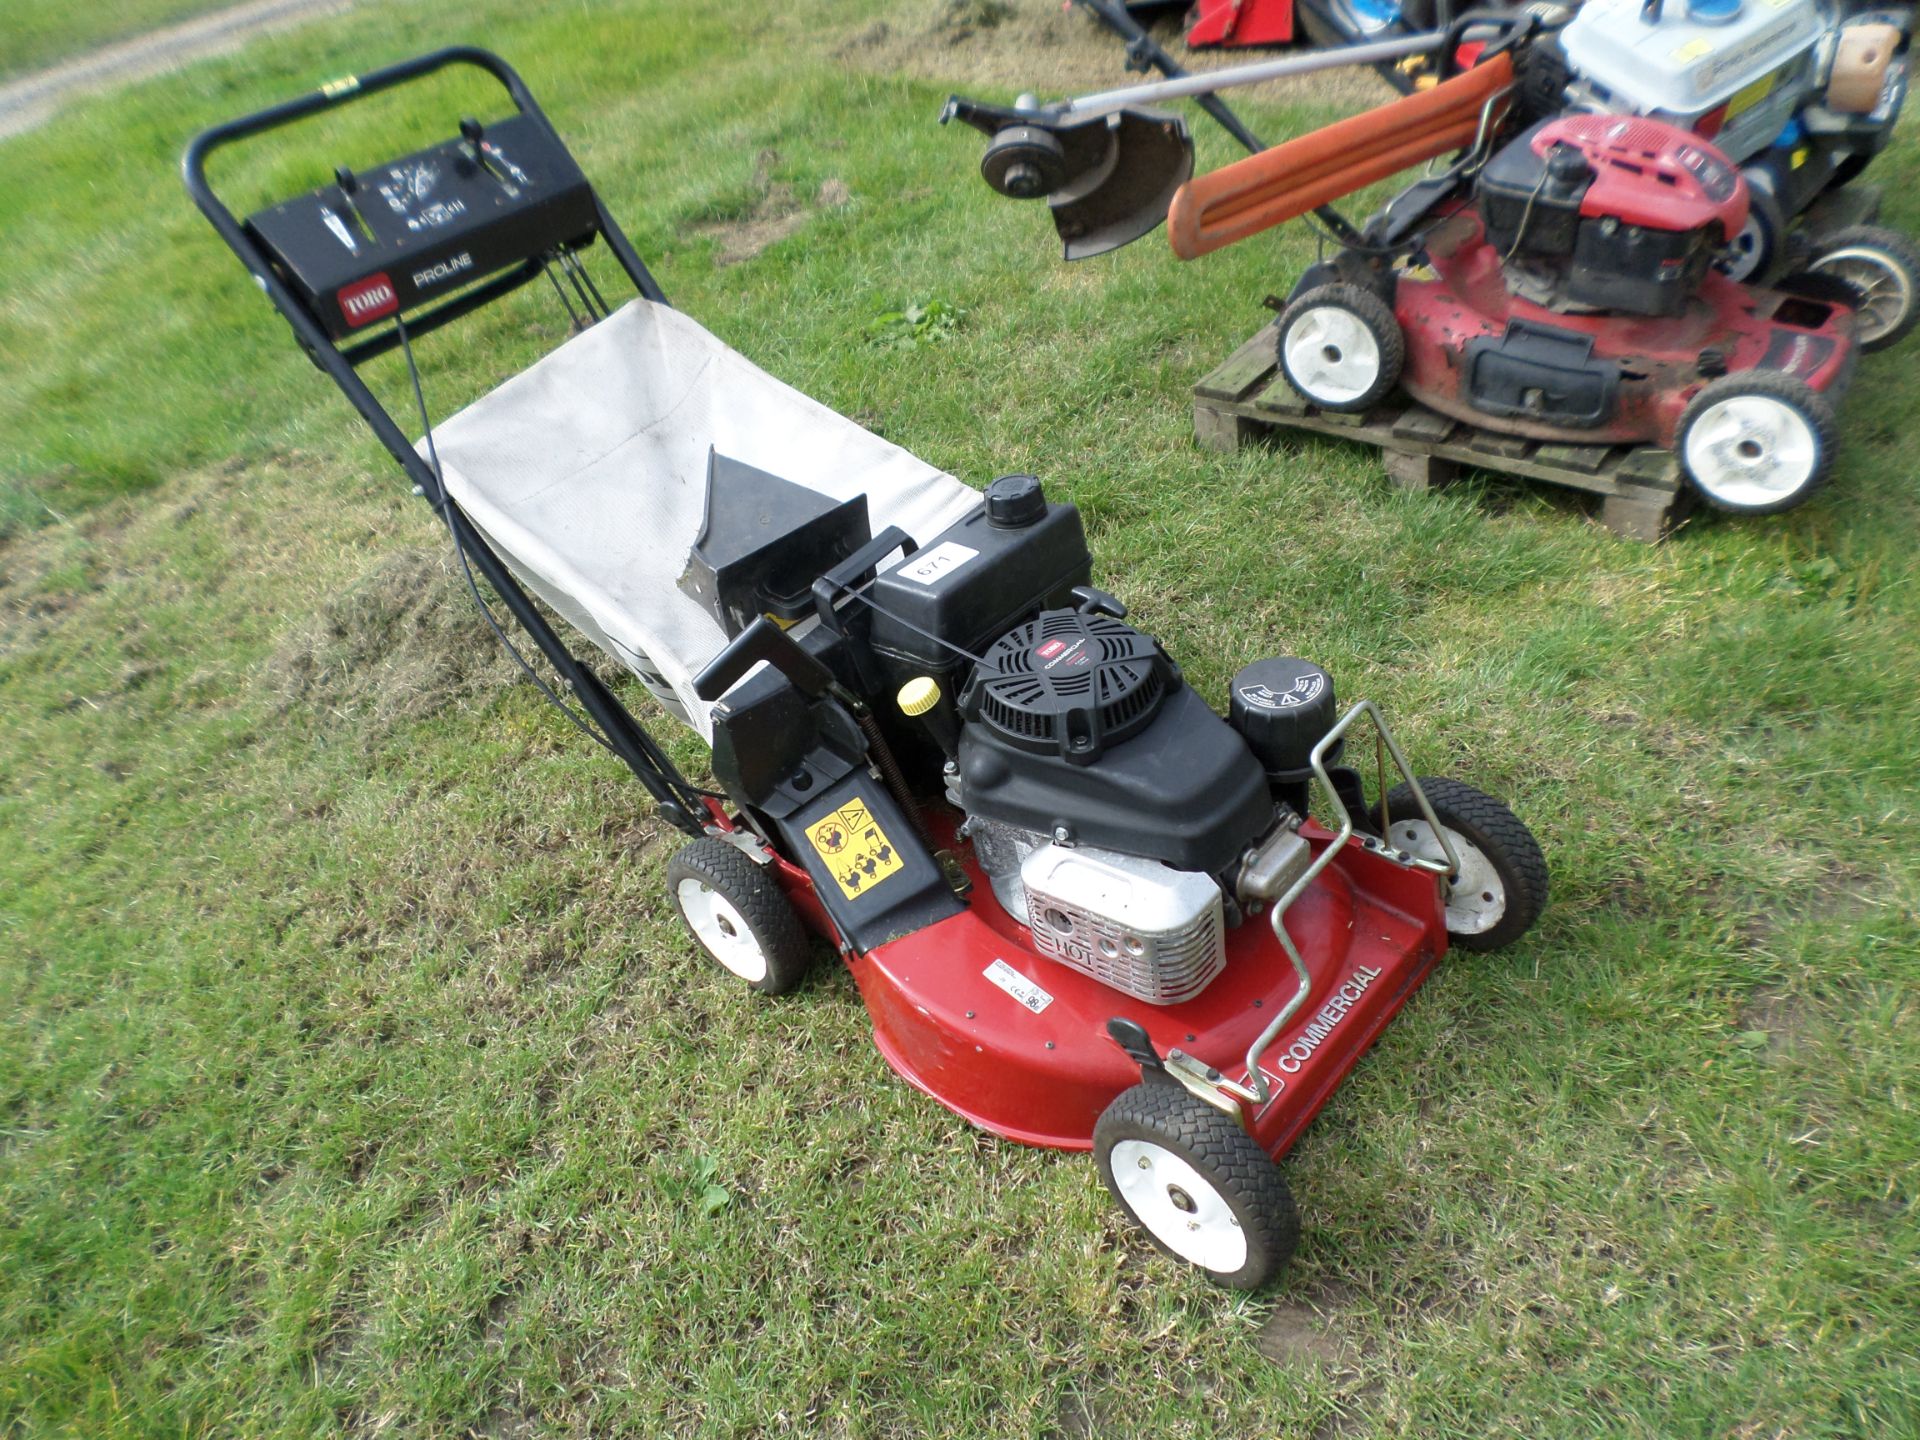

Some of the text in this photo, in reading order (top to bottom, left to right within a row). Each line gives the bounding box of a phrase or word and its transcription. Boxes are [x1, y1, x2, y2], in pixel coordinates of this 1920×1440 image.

[412, 252, 473, 288] PROLINE
[344, 285, 392, 315] TORO
[917, 556, 951, 576] 671
[1055, 938, 1094, 966] HOT
[1278, 965, 1382, 1073] COMMERCIAL
